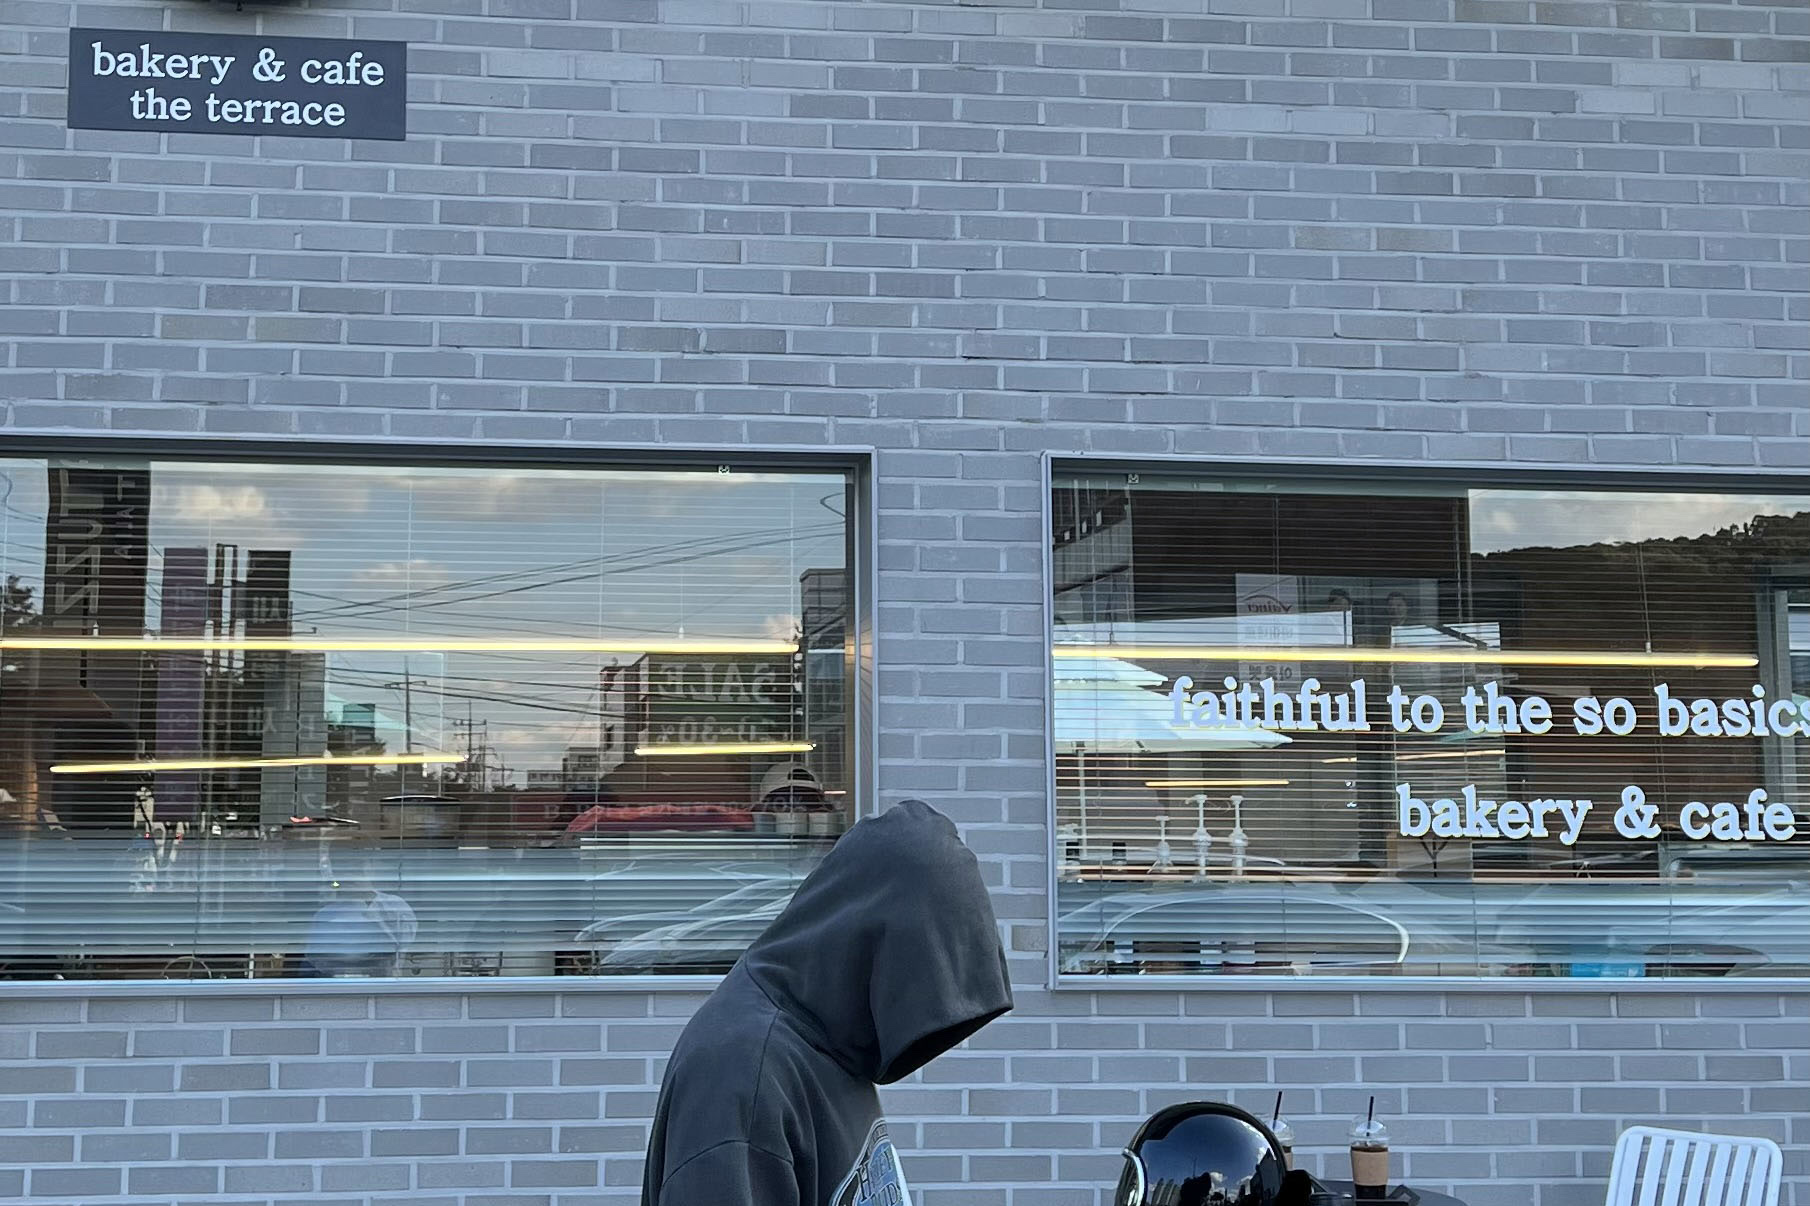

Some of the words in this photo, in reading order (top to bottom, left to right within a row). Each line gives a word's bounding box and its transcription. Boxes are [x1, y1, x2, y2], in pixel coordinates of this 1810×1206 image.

[91, 41, 236, 85] bakery
[252, 47, 286, 83] &
[300, 51, 385, 86] cafe
[129, 87, 192, 121] the
[205, 92, 346, 126] terrace
[1169, 675, 1371, 733] faithful
[1391, 684, 1446, 735] to
[1461, 682, 1553, 736] the
[1573, 696, 1637, 736] so
[1396, 783, 1593, 845] bakery
[1614, 785, 1662, 839] &
[1679, 788, 1797, 841] cafe
